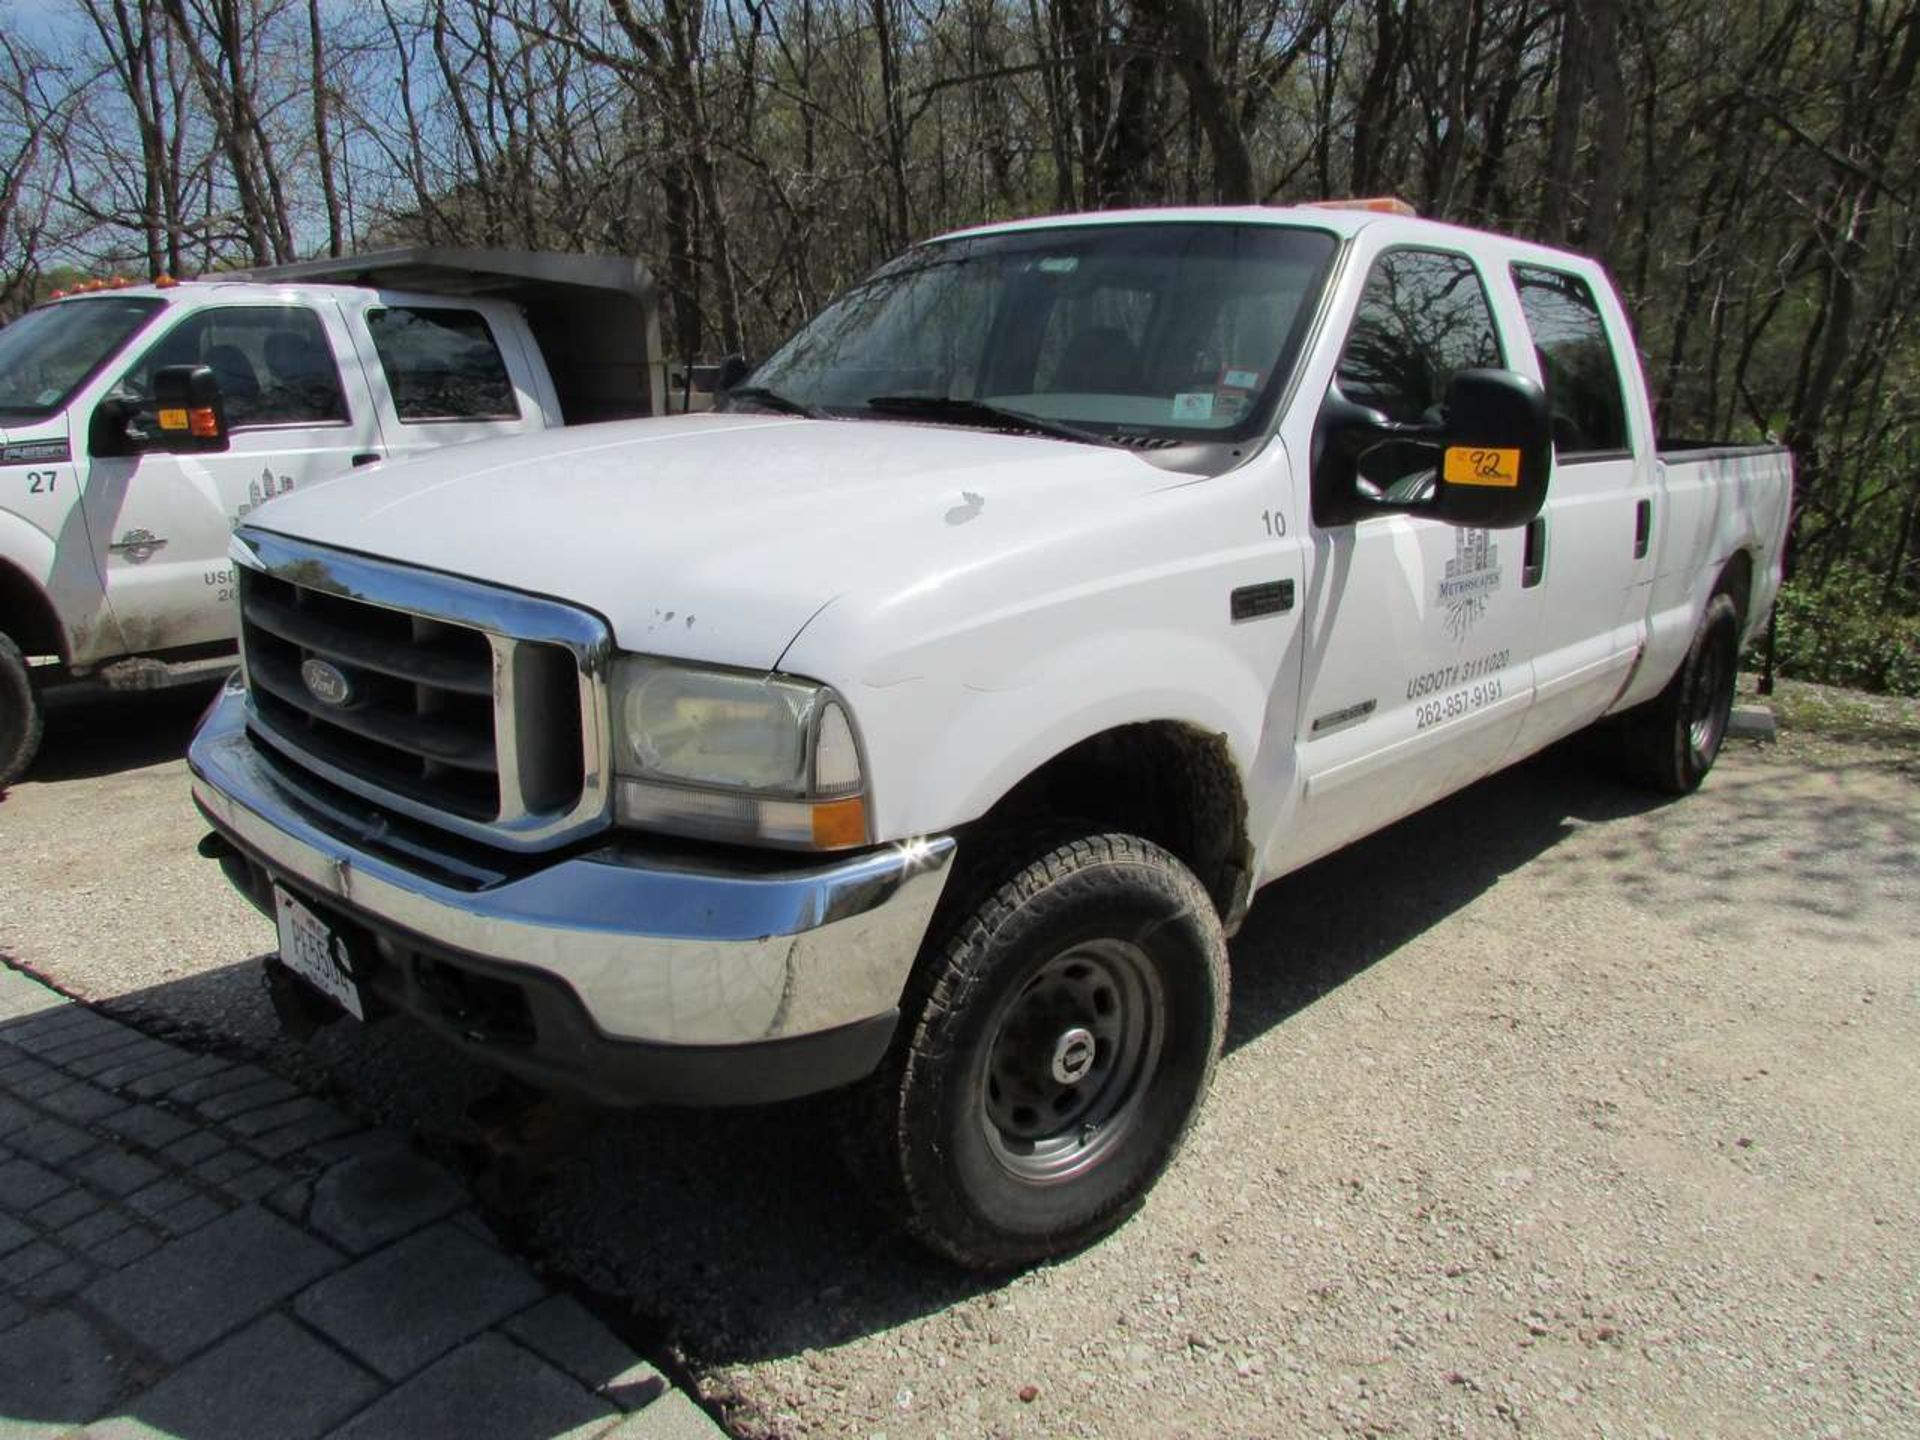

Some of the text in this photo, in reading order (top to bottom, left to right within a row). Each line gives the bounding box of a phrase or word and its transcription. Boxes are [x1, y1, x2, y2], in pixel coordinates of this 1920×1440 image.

[1469, 450, 1511, 478] 92
[27, 471, 57, 493] 27
[1262, 509, 1286, 537] 10
[311, 668, 336, 696] Ford
[1406, 665, 1459, 699] USDOT#
[1416, 677, 1503, 729] 262-857-9191
